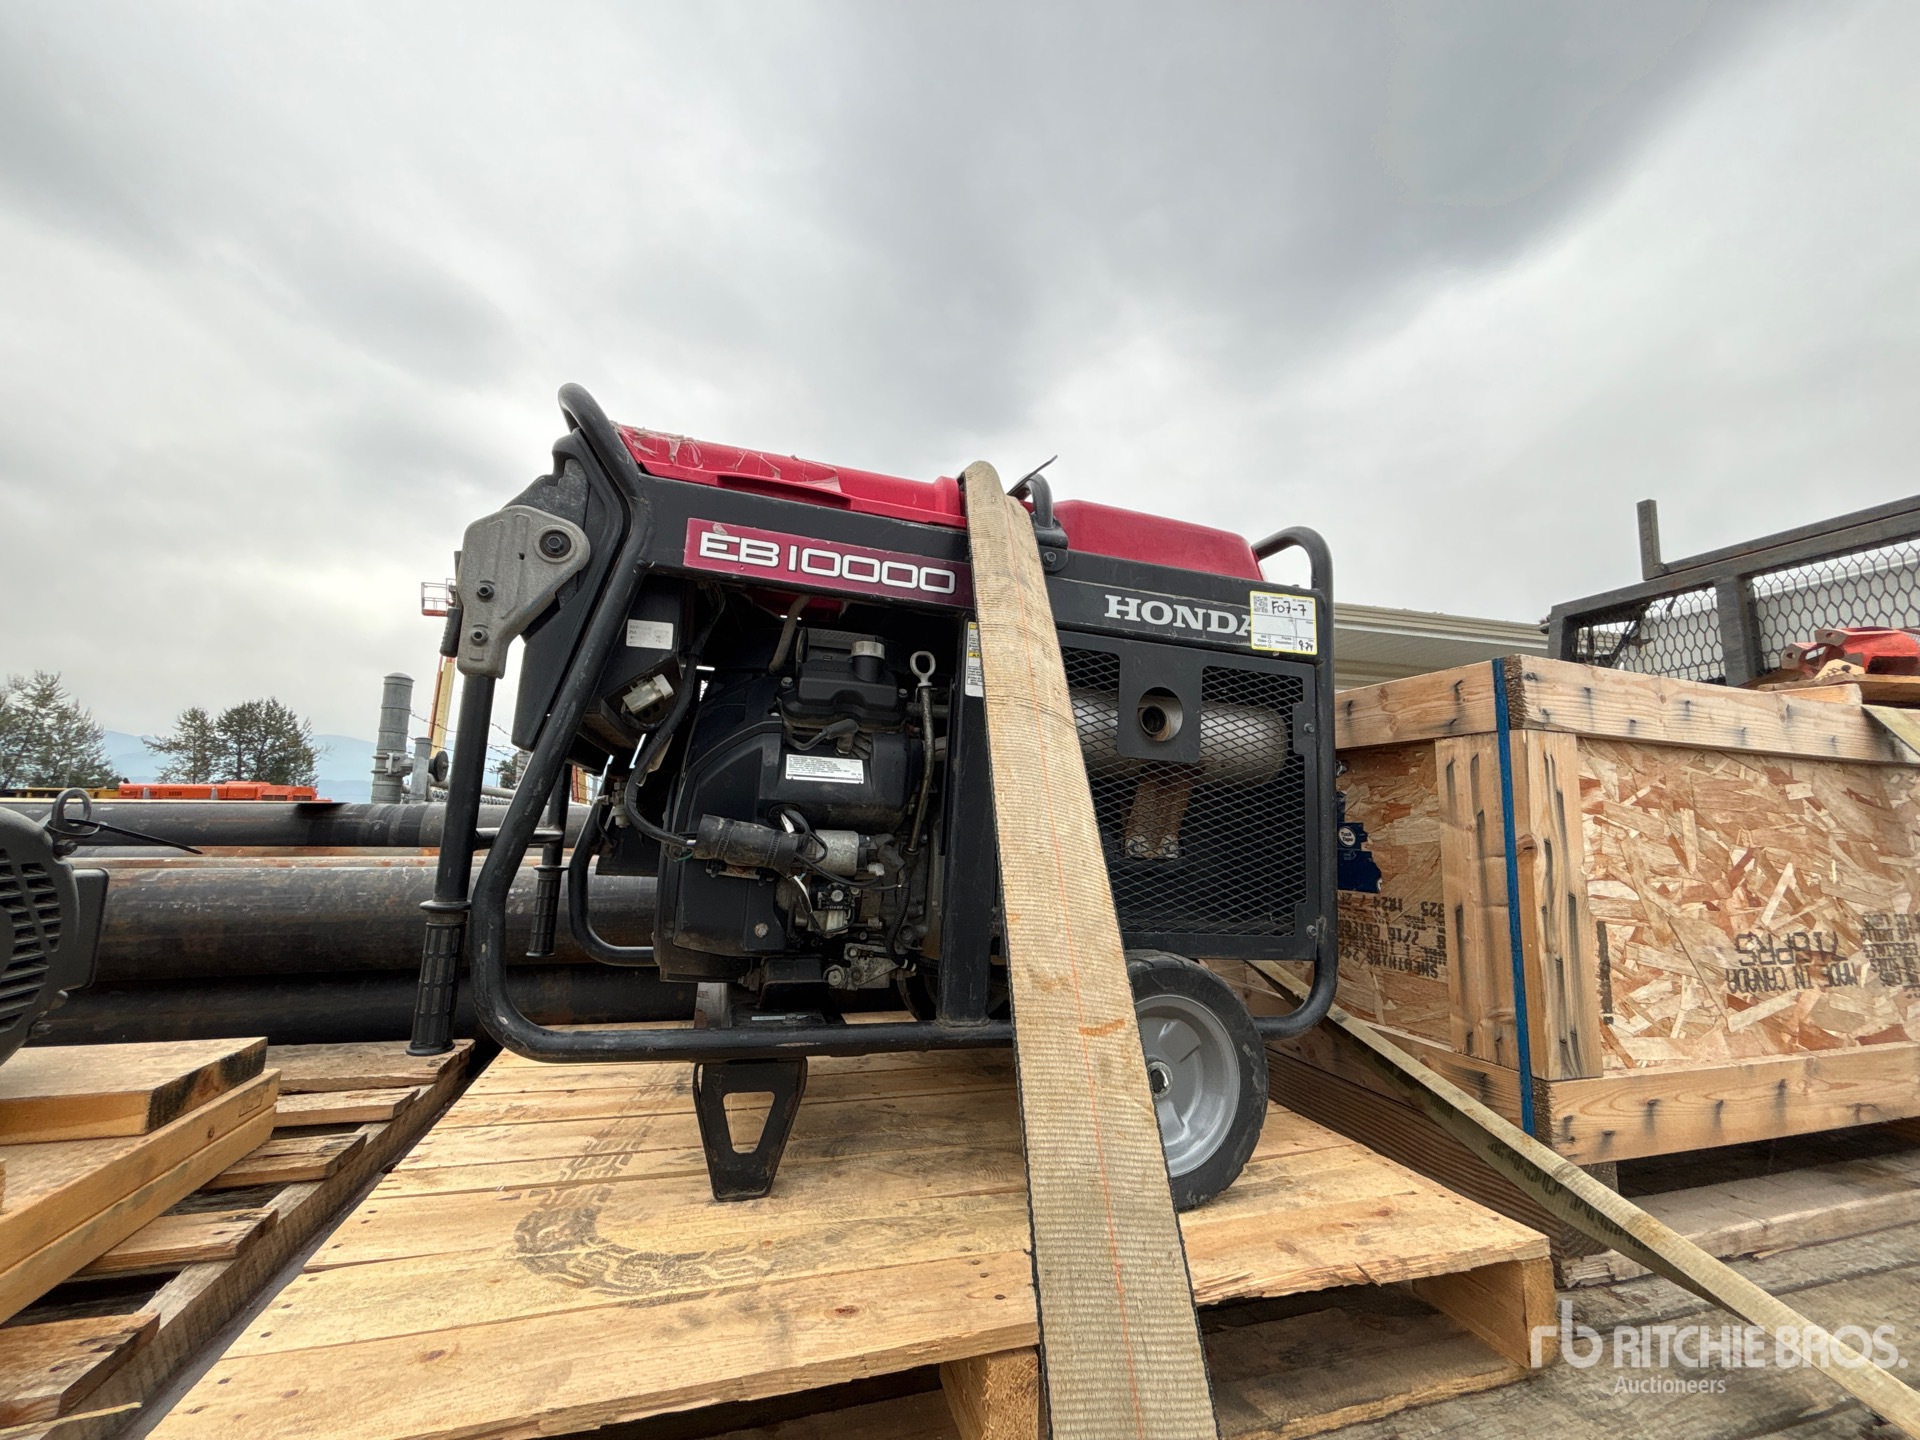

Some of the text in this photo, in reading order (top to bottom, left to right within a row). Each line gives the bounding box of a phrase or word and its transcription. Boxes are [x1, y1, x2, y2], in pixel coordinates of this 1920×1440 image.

[700, 531, 956, 594] EB10000
[1725, 965, 1790, 993] CANADA
[1793, 965, 1814, 989] IN
[1823, 963, 1859, 987] MADE
